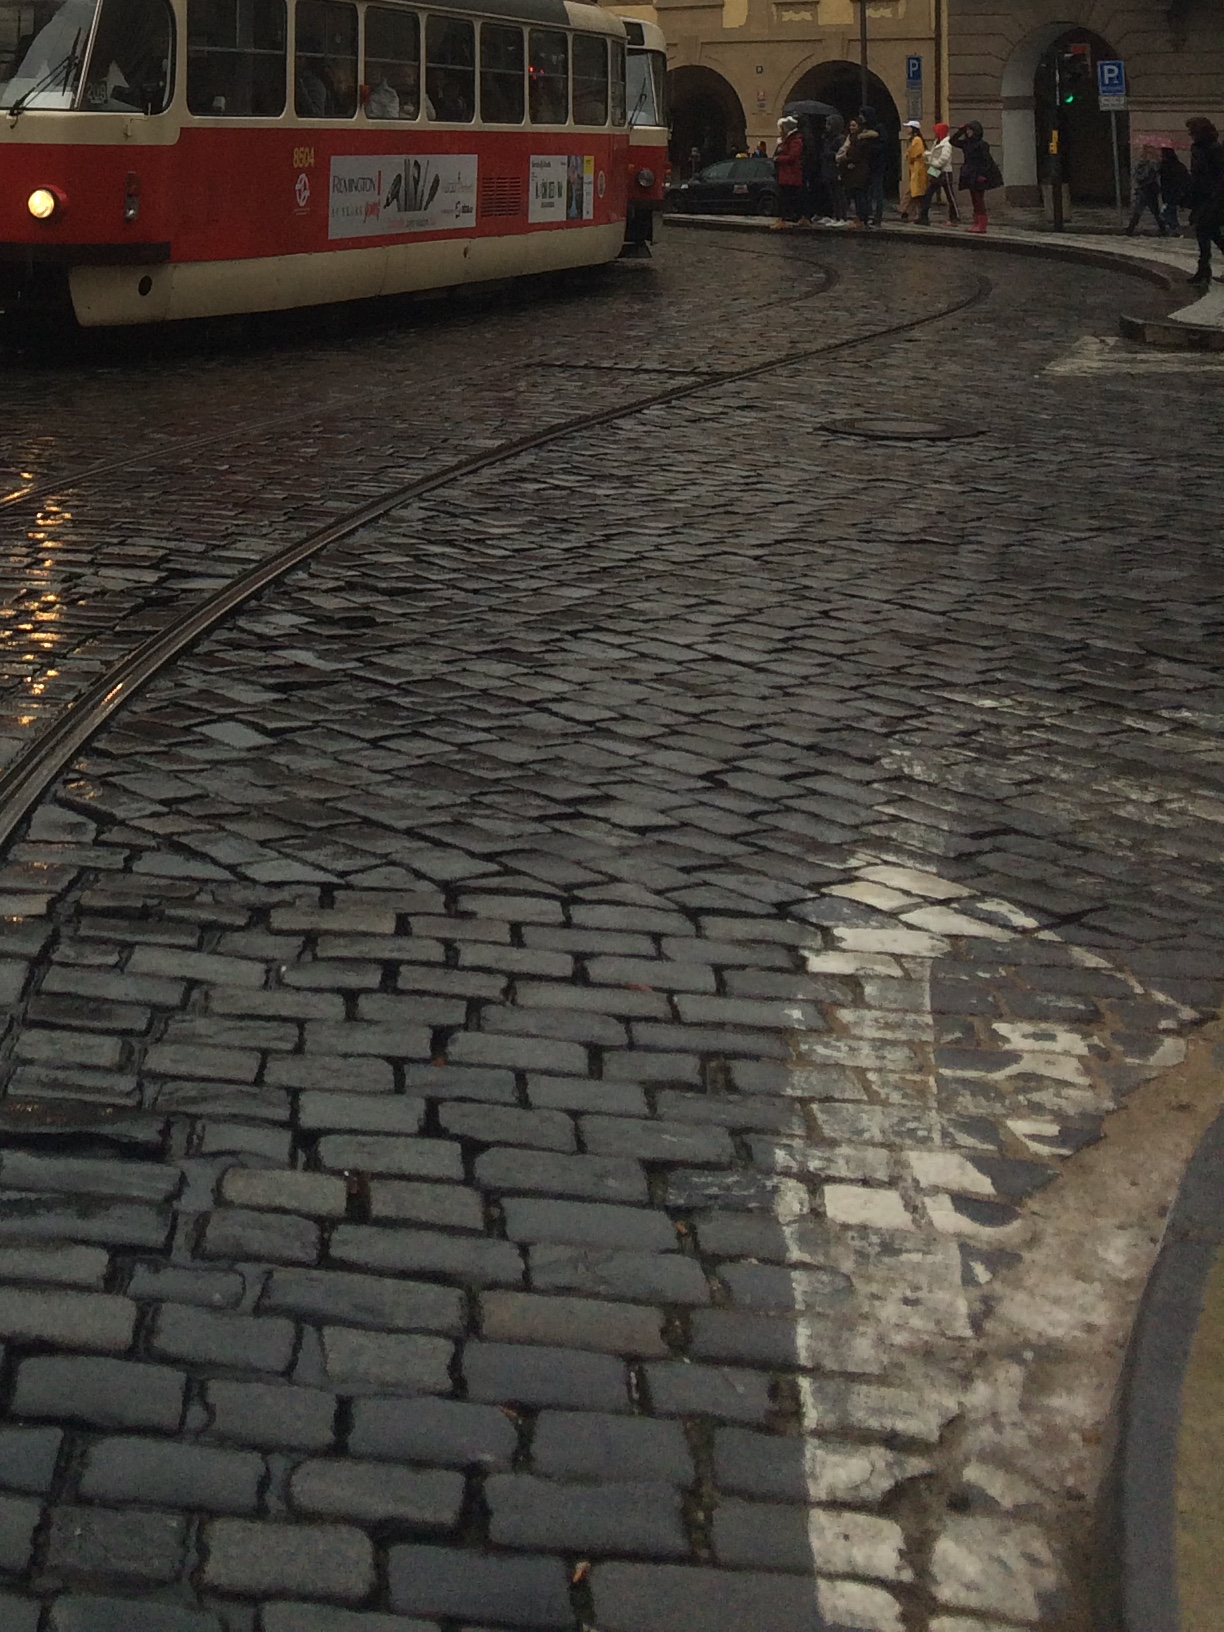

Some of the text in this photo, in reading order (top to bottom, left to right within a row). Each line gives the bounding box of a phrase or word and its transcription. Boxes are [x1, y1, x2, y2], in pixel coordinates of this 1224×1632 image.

[909, 59, 919, 78] P
[1103, 65, 1119, 85] P
[293, 147, 315, 168] 8504
[332, 175, 376, 194] REMINGTON
